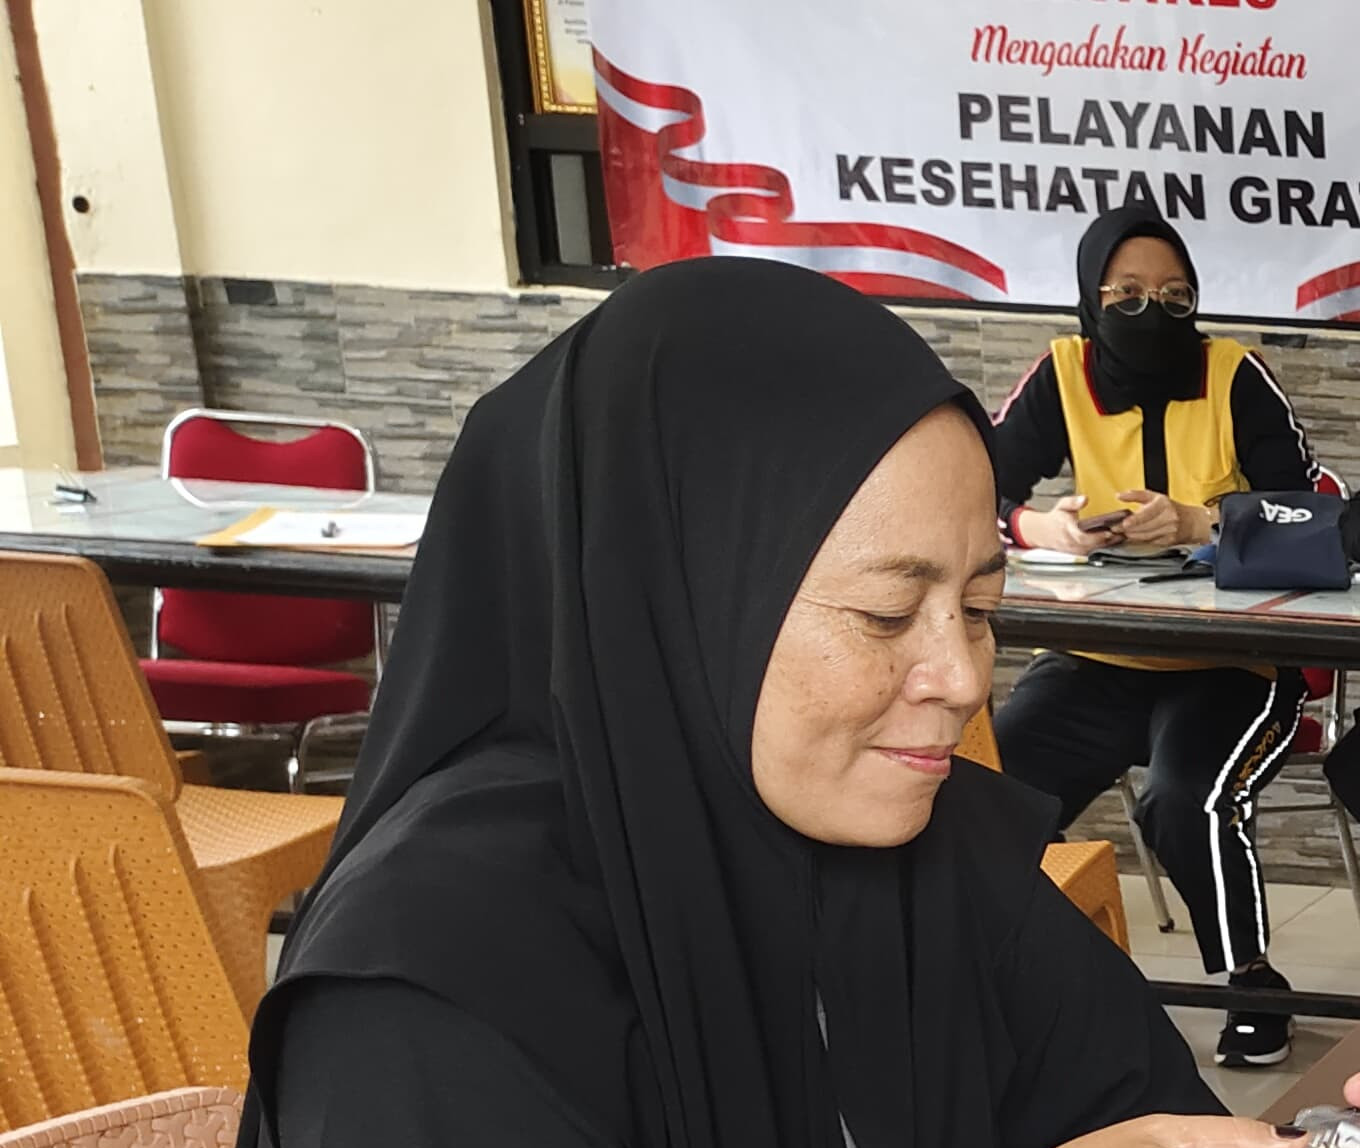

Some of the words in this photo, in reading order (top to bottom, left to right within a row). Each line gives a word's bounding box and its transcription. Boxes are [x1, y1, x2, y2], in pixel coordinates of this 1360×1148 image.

[971, 23, 1168, 77] Mengadakan
[1177, 33, 1307, 85] Kegiatan
[957, 91, 1327, 160] PELAYANAN
[835, 153, 1208, 224] KESEHATAN
[1260, 498, 1313, 524] GEA
